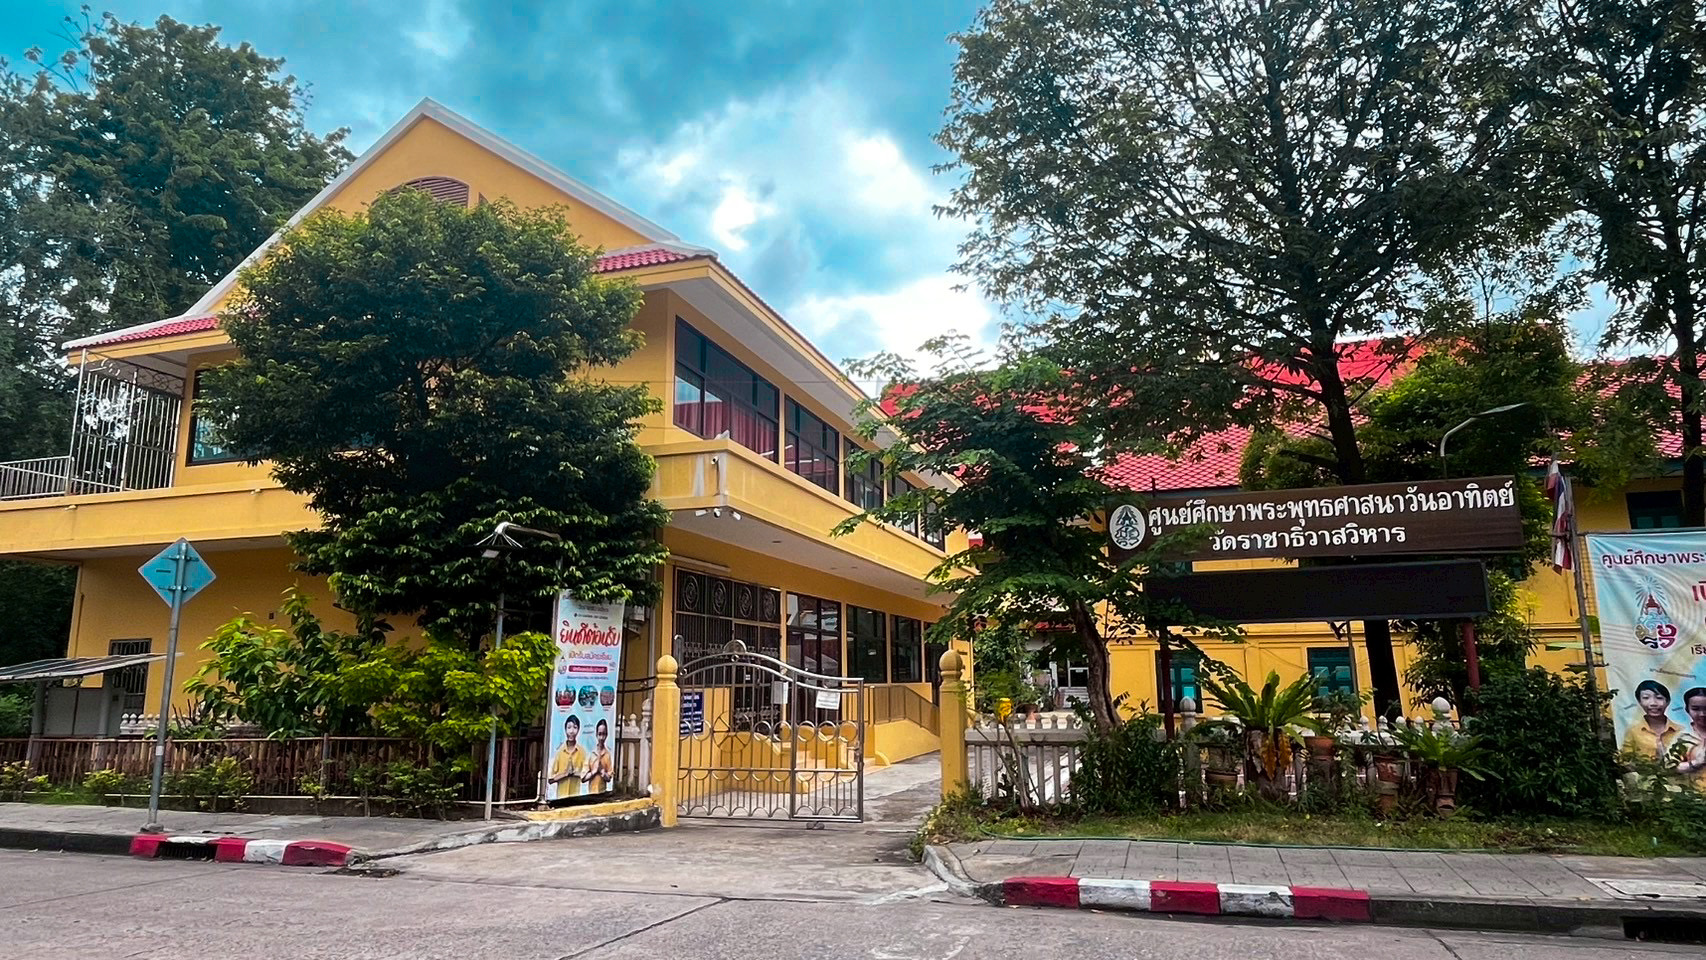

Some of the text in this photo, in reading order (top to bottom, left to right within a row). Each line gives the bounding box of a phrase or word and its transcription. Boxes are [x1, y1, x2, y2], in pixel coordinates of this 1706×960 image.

[1148, 480, 1515, 535] ศูนย์ศึกษาพระพุทธศาสนาวันอาทิตย์
[1208, 523, 1406, 551] วัดราชาธิวาสวิหาร
[1602, 549, 1706, 568] ศูนย์ศึกษาพระ
[560, 620, 620, 647] ยินดีต้อนรับ
